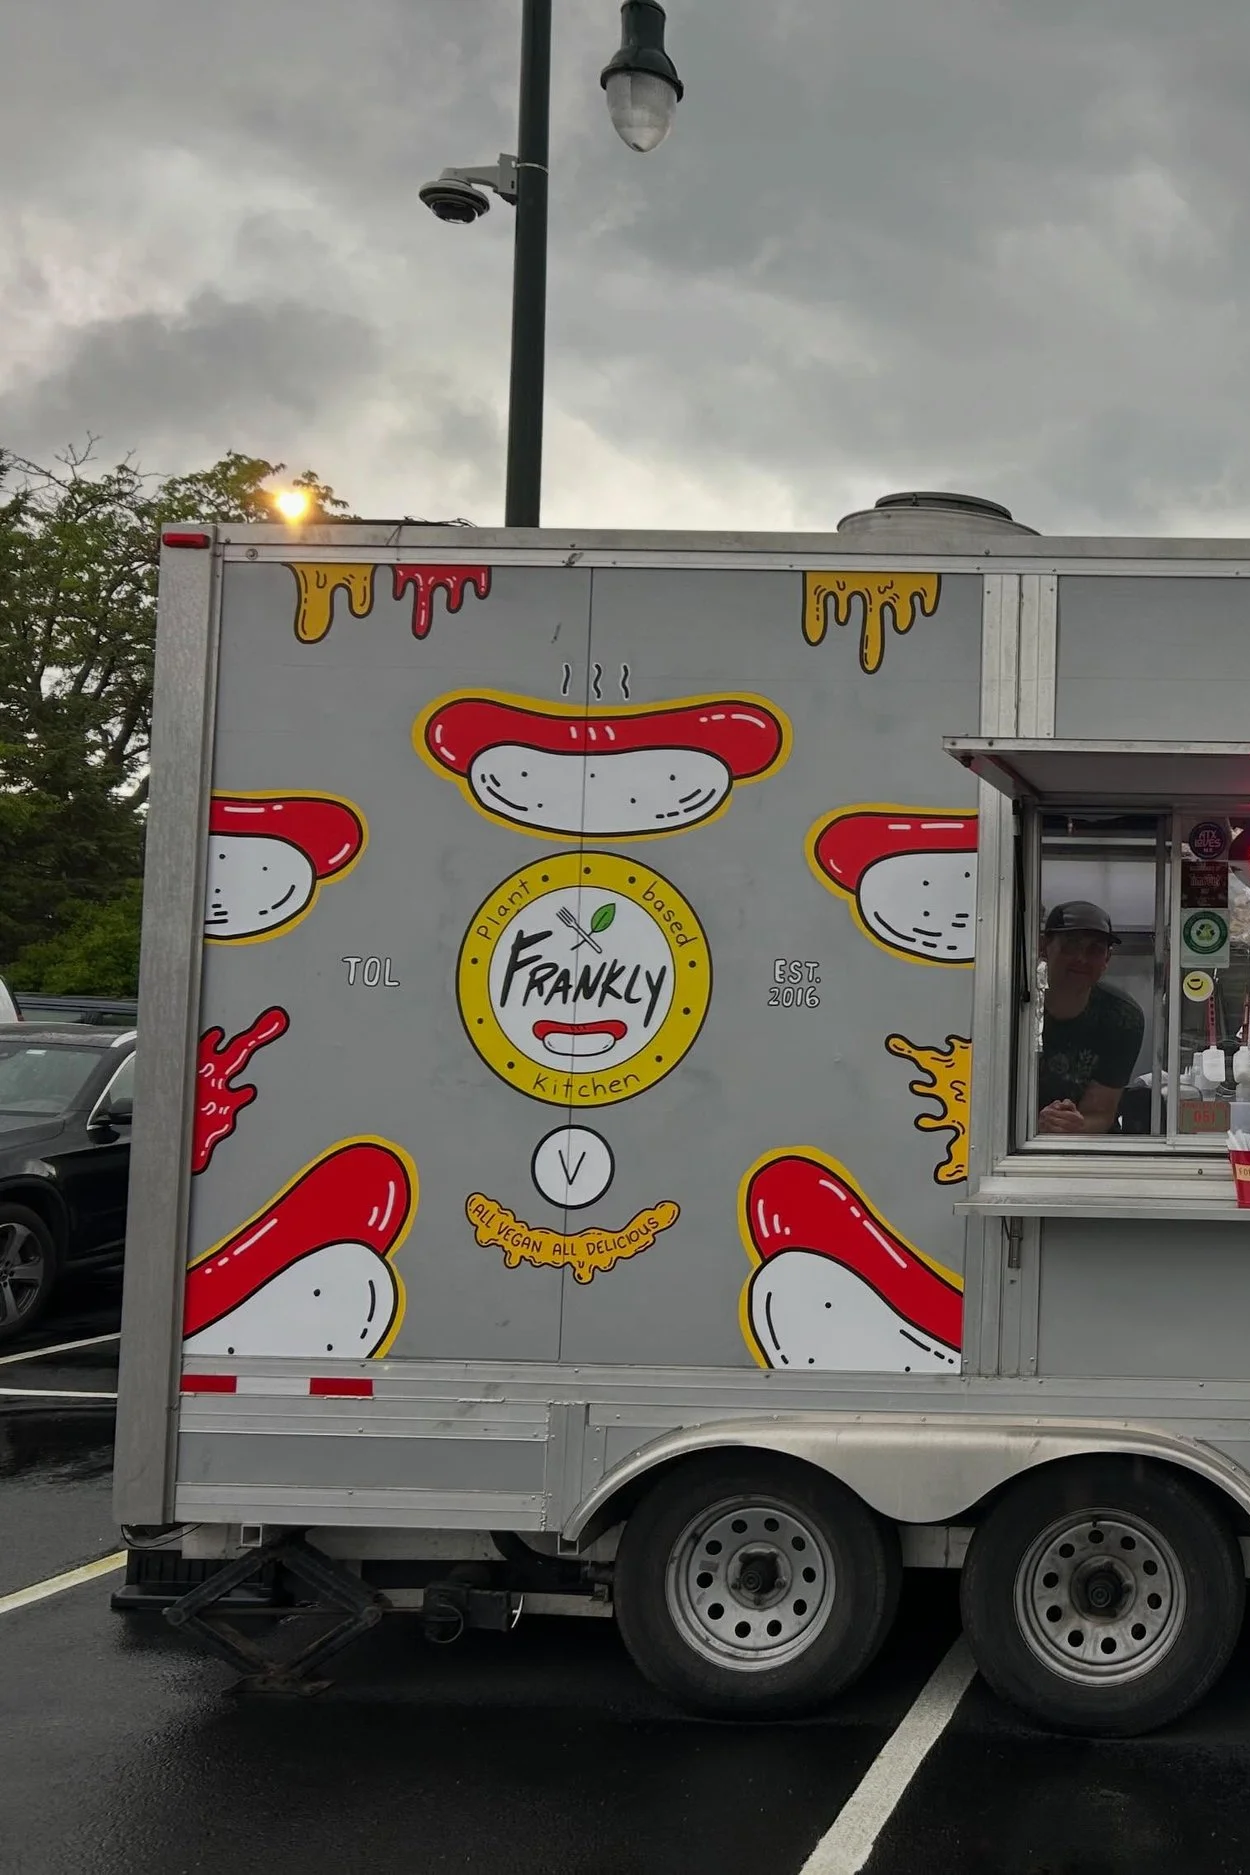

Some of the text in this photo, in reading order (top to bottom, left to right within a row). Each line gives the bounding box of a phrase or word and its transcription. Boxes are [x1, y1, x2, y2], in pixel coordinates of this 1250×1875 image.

[476, 878, 698, 948] Plant based
[341, 956, 401, 987] TOL
[773, 958, 822, 985] EST.
[767, 985, 821, 1009] 2016
[532, 1072, 640, 1099] Kitchen
[558, 1149, 586, 1185] V
[472, 1203, 660, 1256] ALL VEGAN ALL DELICIOUS
